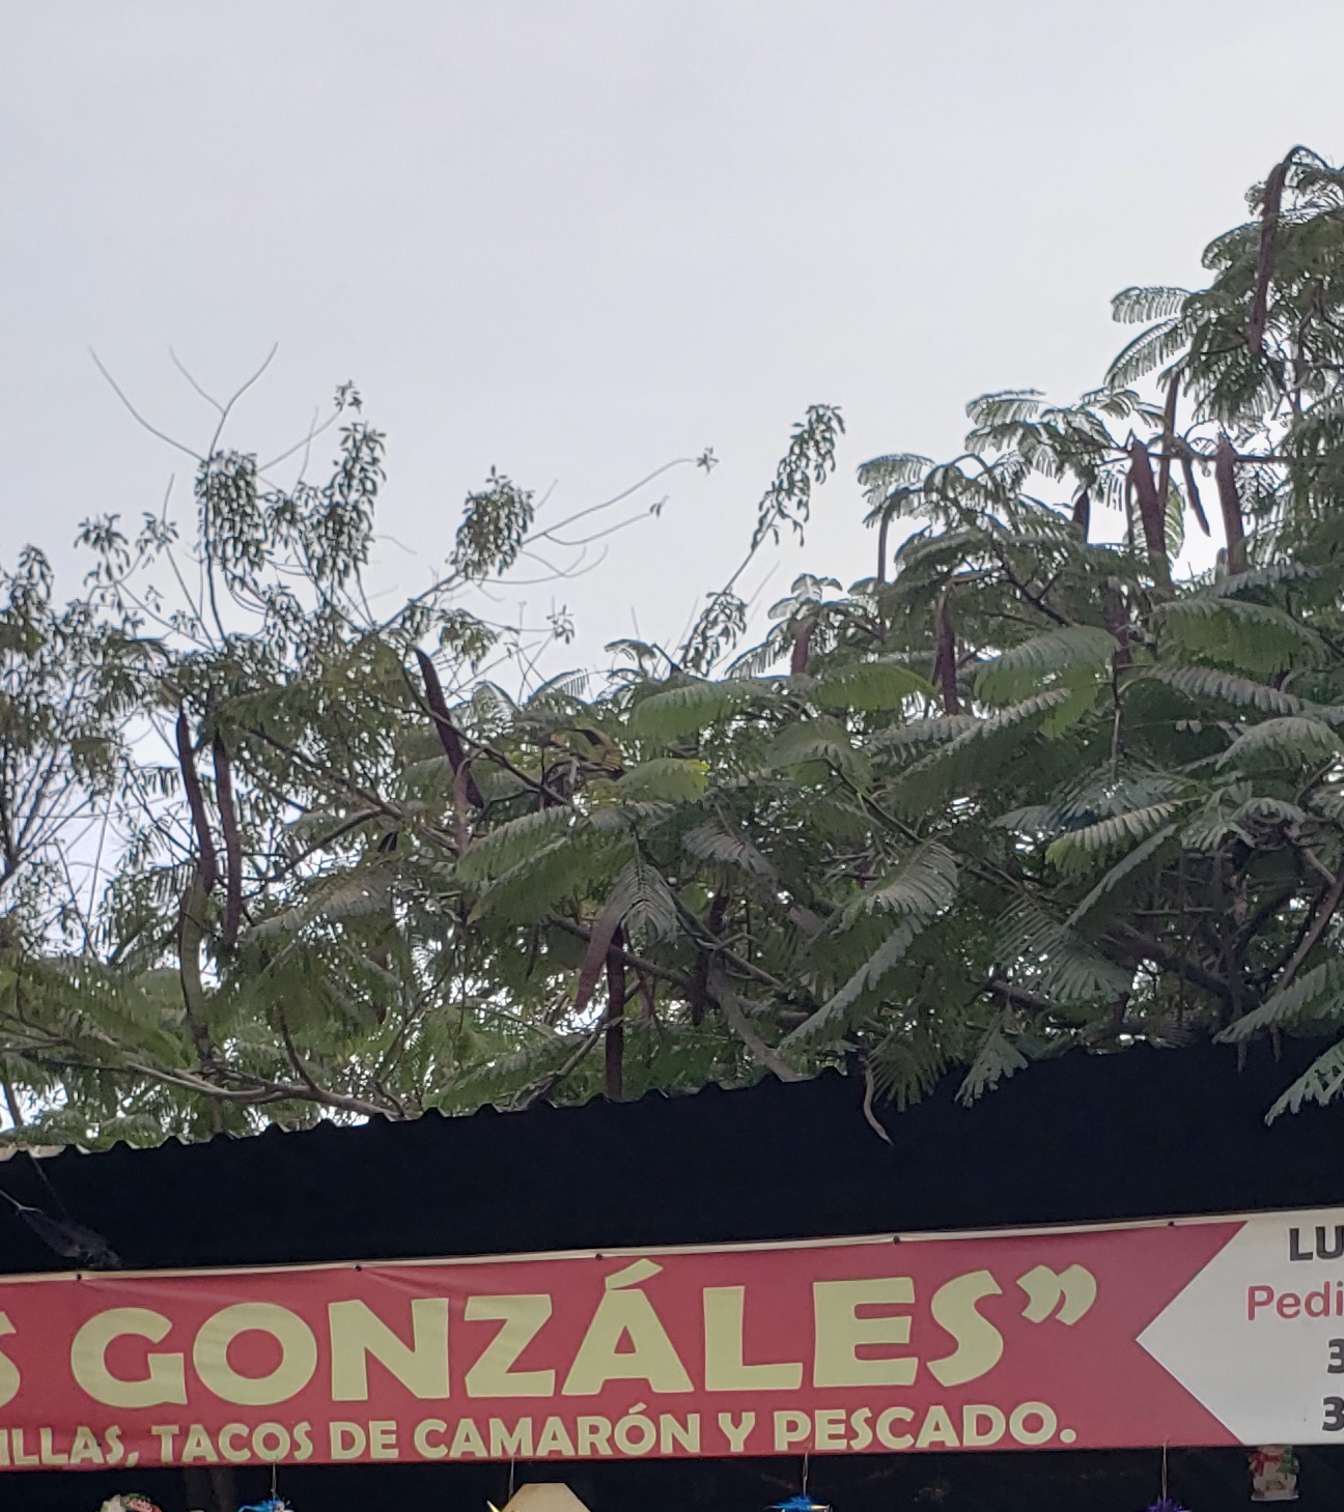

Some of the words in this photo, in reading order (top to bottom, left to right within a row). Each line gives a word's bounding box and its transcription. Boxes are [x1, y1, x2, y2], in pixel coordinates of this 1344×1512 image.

[151, 1420, 314, 1465] TACOS
[329, 1420, 399, 1461] DE
[413, 1402, 701, 1459] CAMARÓN
[717, 1412, 756, 1452] Y
[773, 1401, 1078, 1451] PESCADO.
